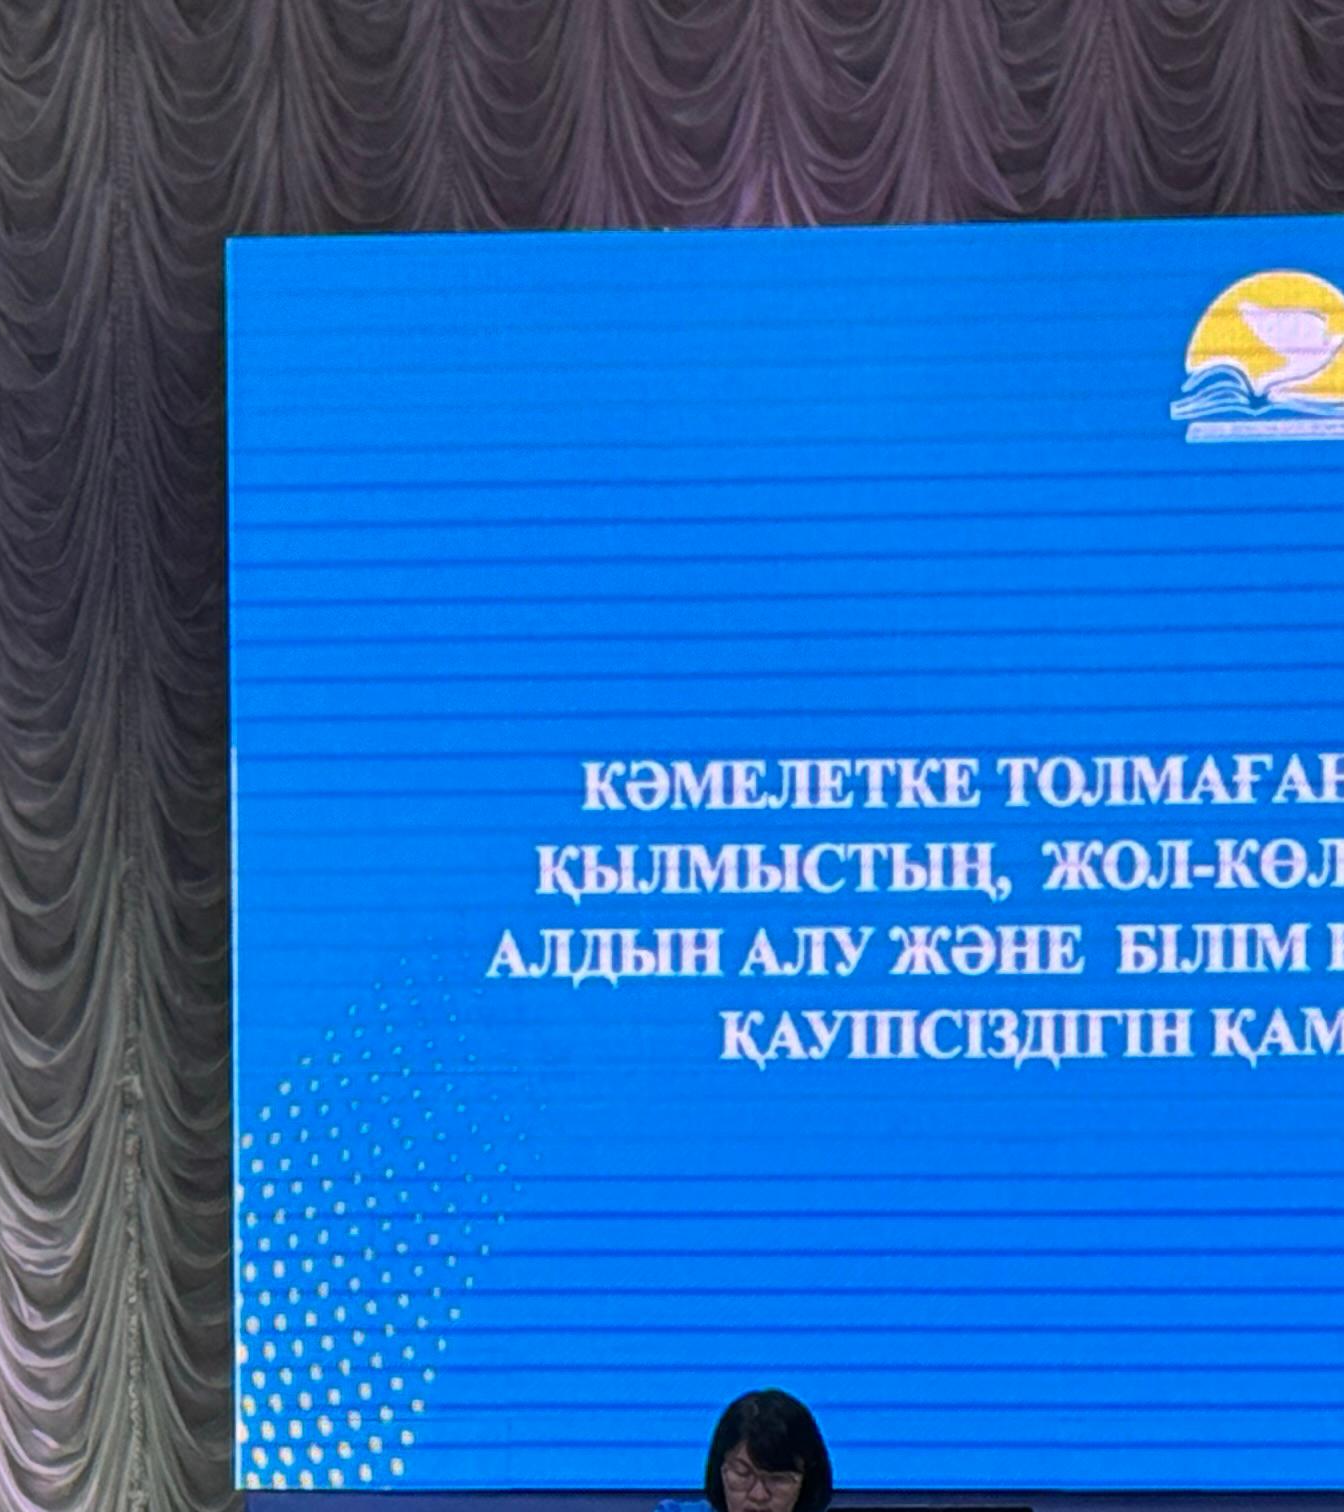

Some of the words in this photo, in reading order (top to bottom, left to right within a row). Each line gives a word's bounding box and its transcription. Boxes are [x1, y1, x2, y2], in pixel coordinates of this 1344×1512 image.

[581, 757, 981, 811] КӘМЕЛЕТКЕ
[535, 841, 1012, 906] ҚЫЛМЫСТЫҢ,
[485, 928, 724, 988] АЛДЫН
[738, 927, 876, 977] АЛУ
[888, 924, 1086, 976] ЖӘНЕ
[1116, 923, 1312, 975] БІЛІМ
[719, 1008, 1196, 1071] ҚАУІПСІЗДІГІН
